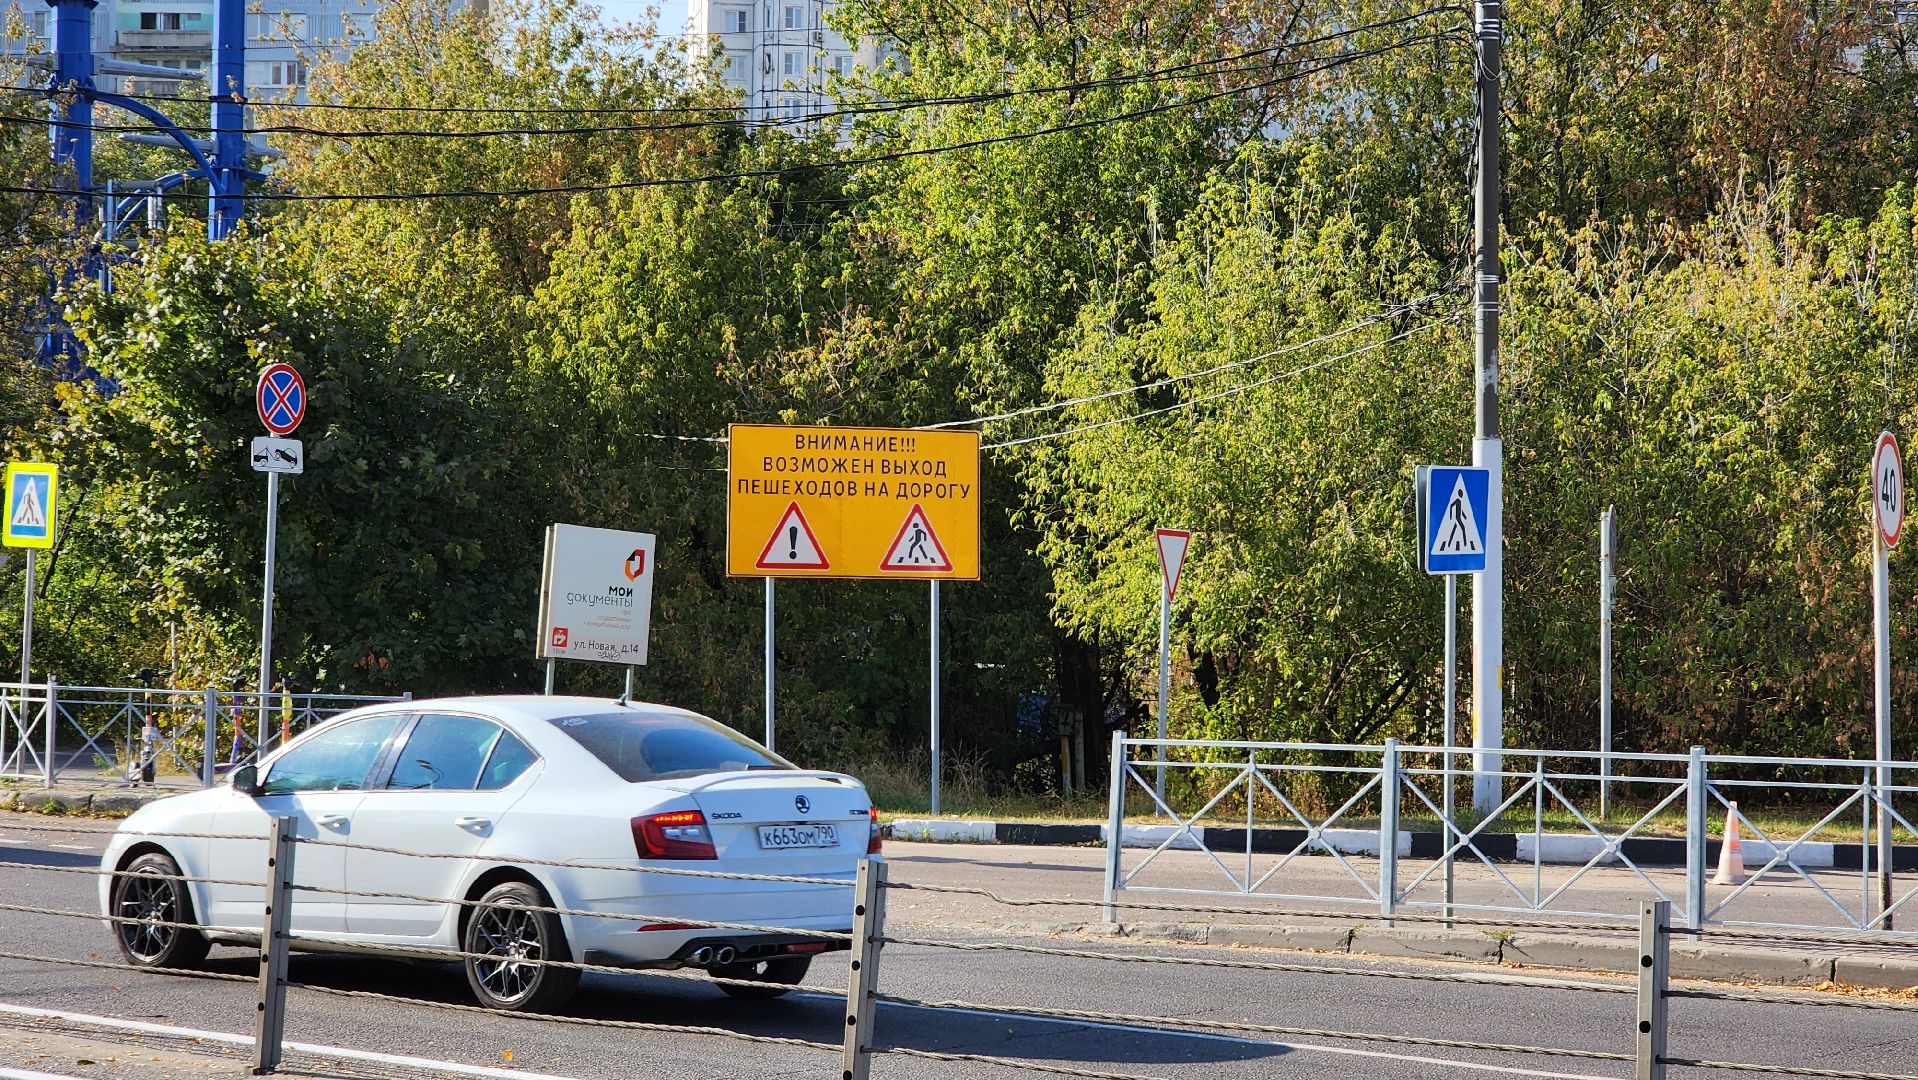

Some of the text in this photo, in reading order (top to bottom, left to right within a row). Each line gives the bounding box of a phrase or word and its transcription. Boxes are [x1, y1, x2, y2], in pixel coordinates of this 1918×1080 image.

[795, 434, 916, 453] ВНИМАНИЕ!!!
[763, 456, 947, 479] ВОЗМОЖЕН ВЫХОД
[738, 479, 971, 500] ПЕШЕХОДОВ НА ДОРОГУ
[1881, 467, 1897, 513] 40
[566, 592, 633, 608] документы
